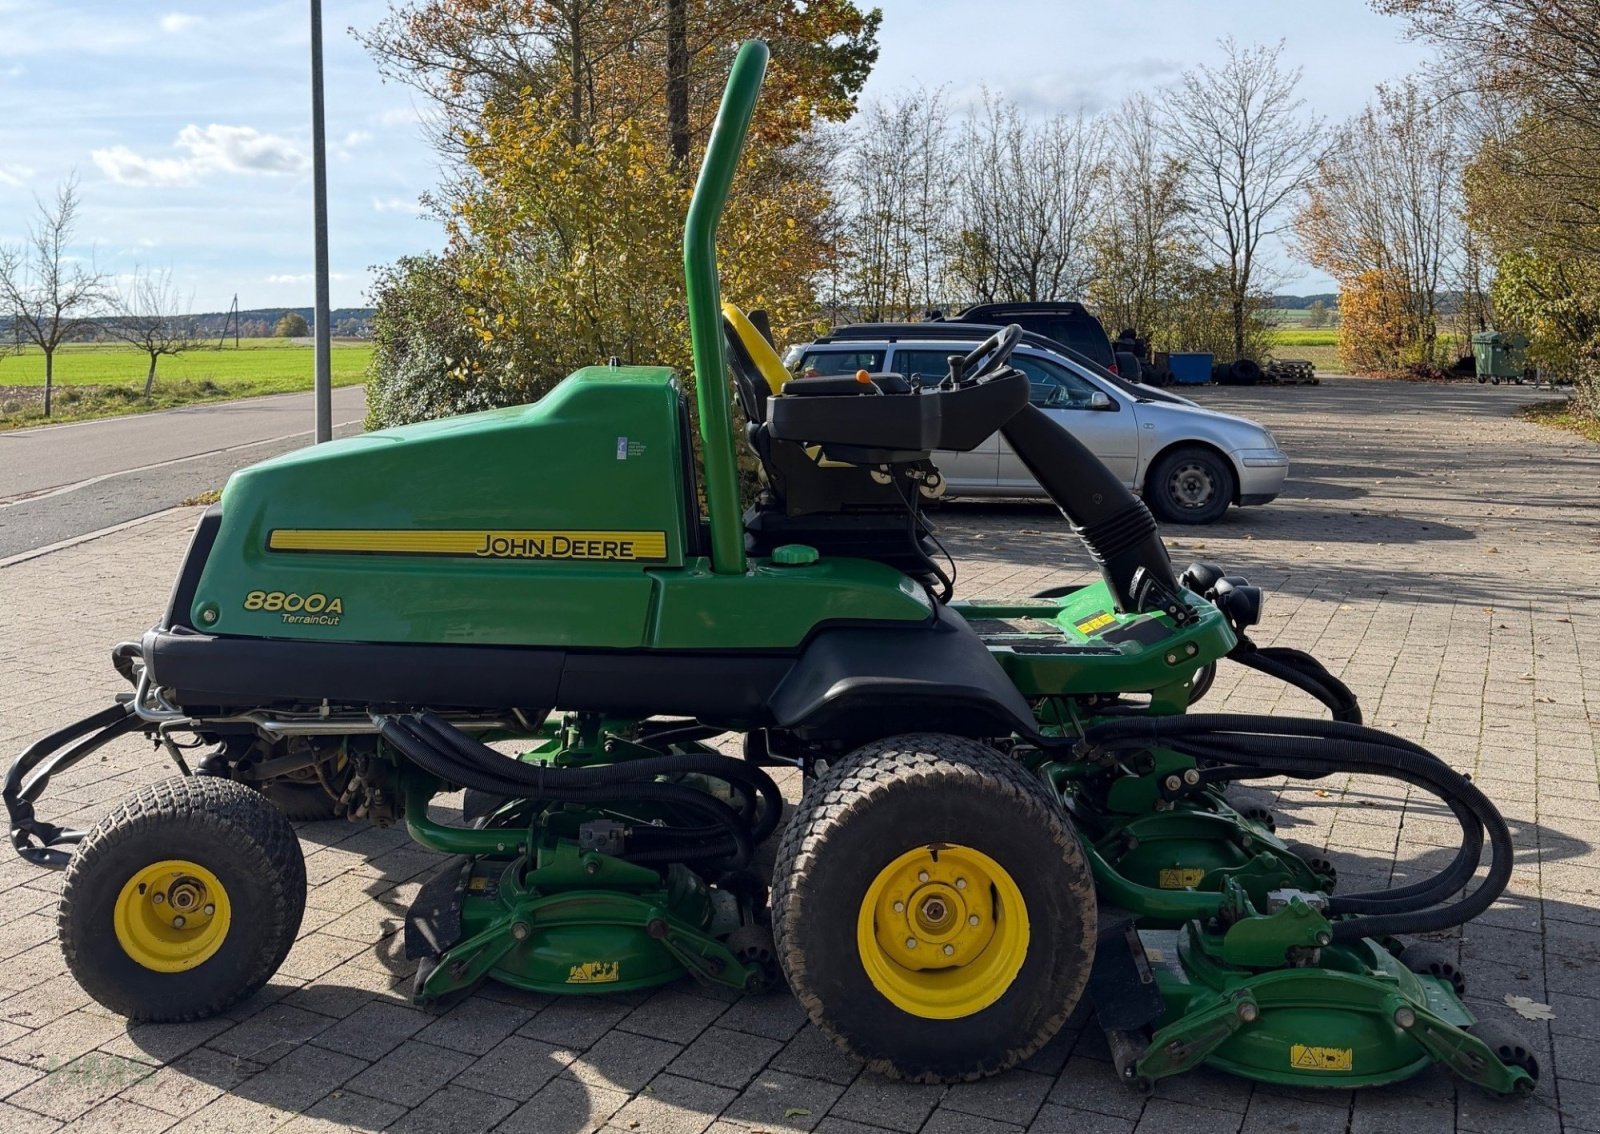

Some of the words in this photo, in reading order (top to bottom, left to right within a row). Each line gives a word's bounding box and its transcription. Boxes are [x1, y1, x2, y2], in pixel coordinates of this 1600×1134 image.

[476, 534, 546, 556] JOHN
[551, 535, 635, 558] DEERE
[243, 590, 343, 614] 8800A
[281, 613, 341, 626] TerrainCut
